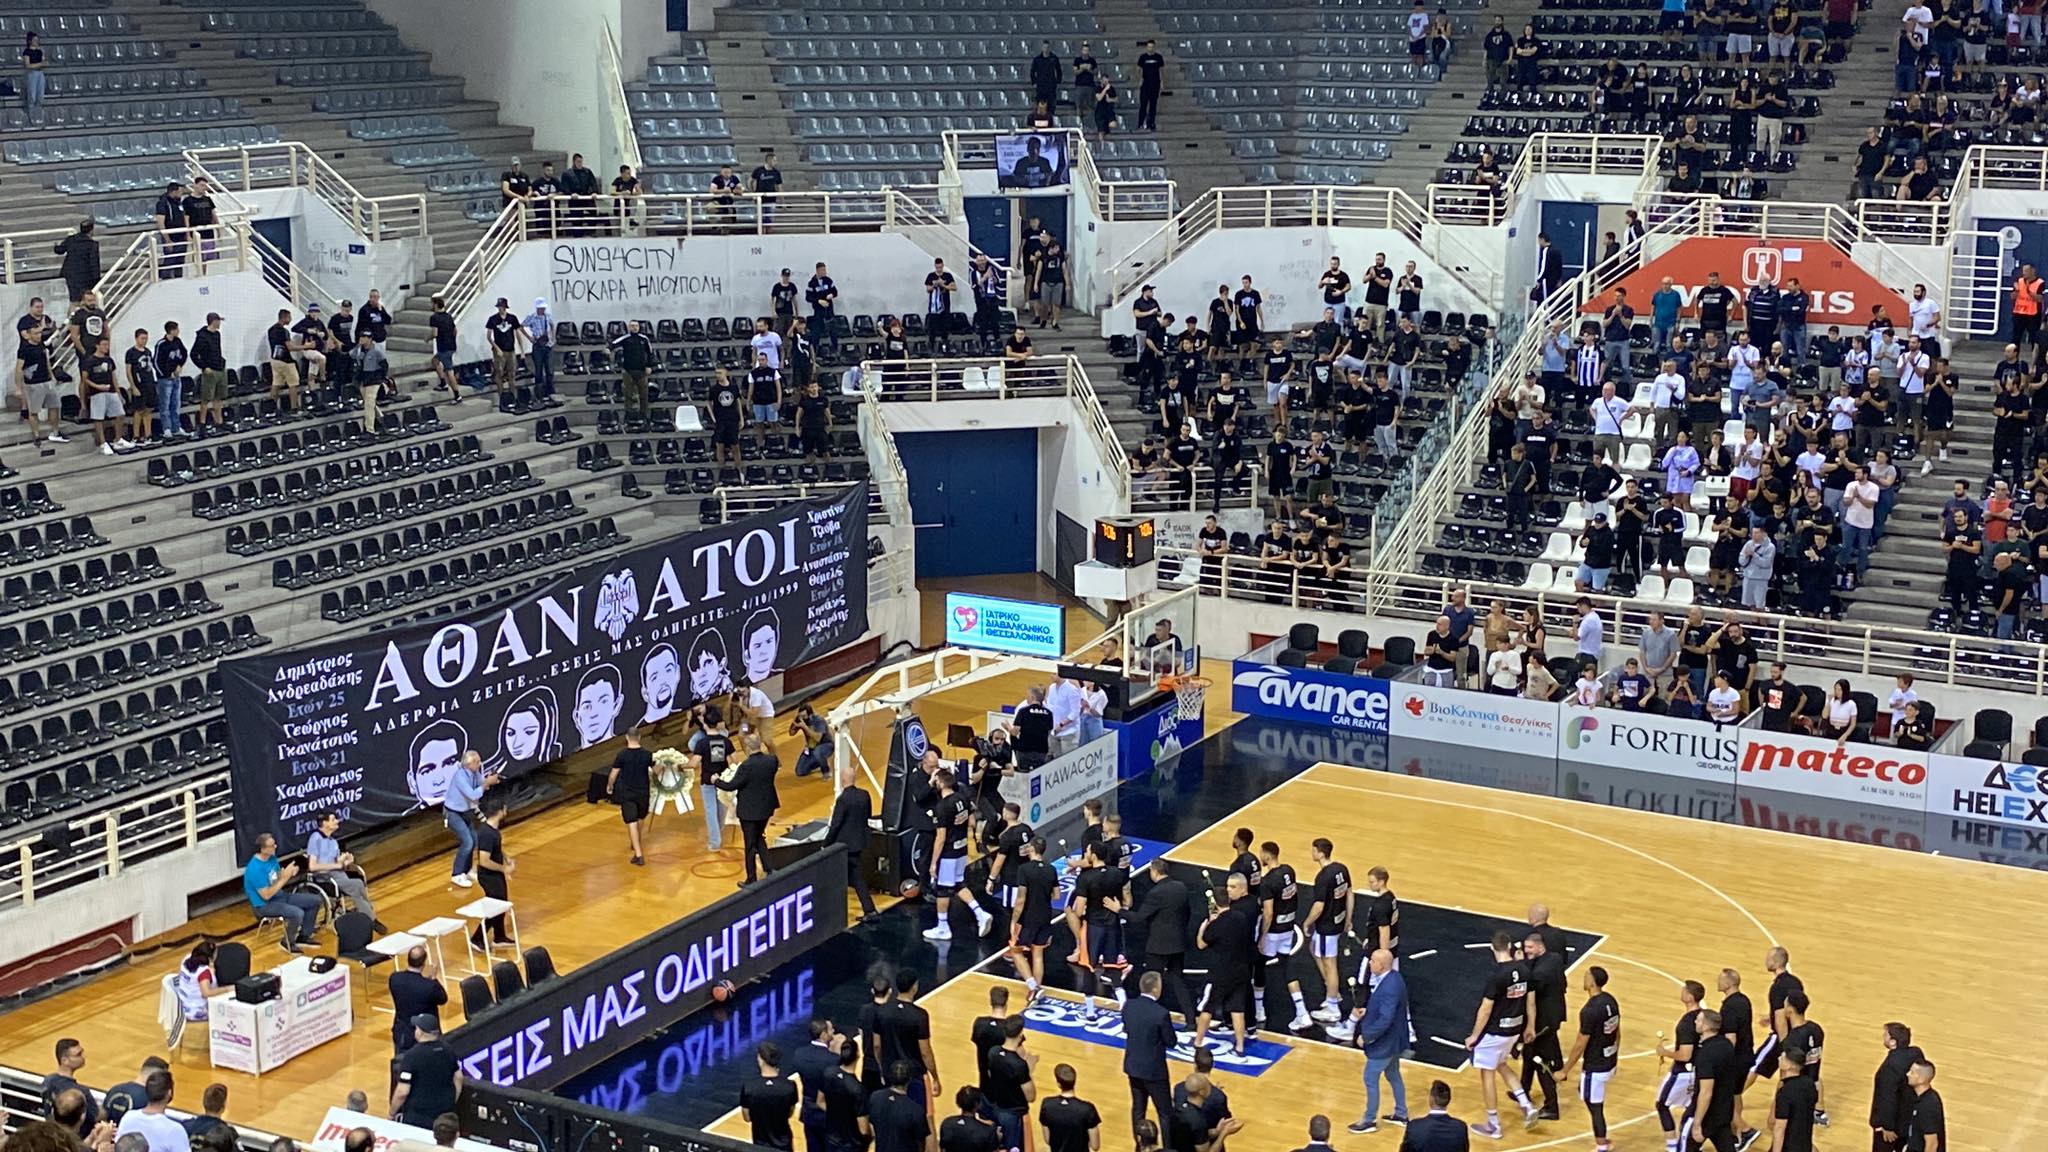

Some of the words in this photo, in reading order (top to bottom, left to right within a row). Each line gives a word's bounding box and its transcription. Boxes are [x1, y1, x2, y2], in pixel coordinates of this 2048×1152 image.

[554, 245, 675, 274] SUN94CITY
[552, 279, 628, 303] ΠΑΟΚΑΡΑ
[638, 276, 722, 297] ΗΛΙΟΥΠΟΛΗ
[986, 610, 1020, 621] ΙΑΤΡΙΚΟ
[986, 619, 1050, 634] ΔΙΑΒΑΛΚΑΝΙΚΟ
[986, 629, 1054, 644] ΘΕΣΣΑΛΟΝΙΚΗΣ
[275, 653, 353, 682] Δημήτριος
[266, 669, 363, 704] Ανδρεαδάκης
[372, 698, 460, 735] ΑΔΕΡΦΙΑ
[611, 636, 642, 656] ΜΑΣ
[1259, 677, 1389, 720] avance
[287, 699, 324, 719] Ετών
[329, 691, 345, 708] 25
[283, 713, 349, 739] Γεώργιος
[1332, 715, 1351, 726] CAR
[1352, 719, 1387, 732] RENTAL
[278, 730, 359, 760] Γκανάτσιος
[1610, 723, 1737, 763] FORTIUS
[292, 755, 326, 776] Ετών
[330, 750, 346, 766] 21
[1045, 749, 1103, 791] KAWACOM
[1740, 740, 1926, 785] mateco
[276, 768, 363, 801] Χαράλαμπος
[1900, 790, 1922, 801] HIGH
[280, 787, 363, 820] Ζαπουνίδης
[1283, 874, 1291, 886] 2
[1335, 872, 1344, 886] 21
[458, 1017, 552, 1087] ΣΕΙΣ
[562, 970, 646, 1056] ΜΑΣ
[655, 885, 813, 1004] ΟΔΗΓΕΙΤΕ
[1512, 970, 1519, 982] 9
